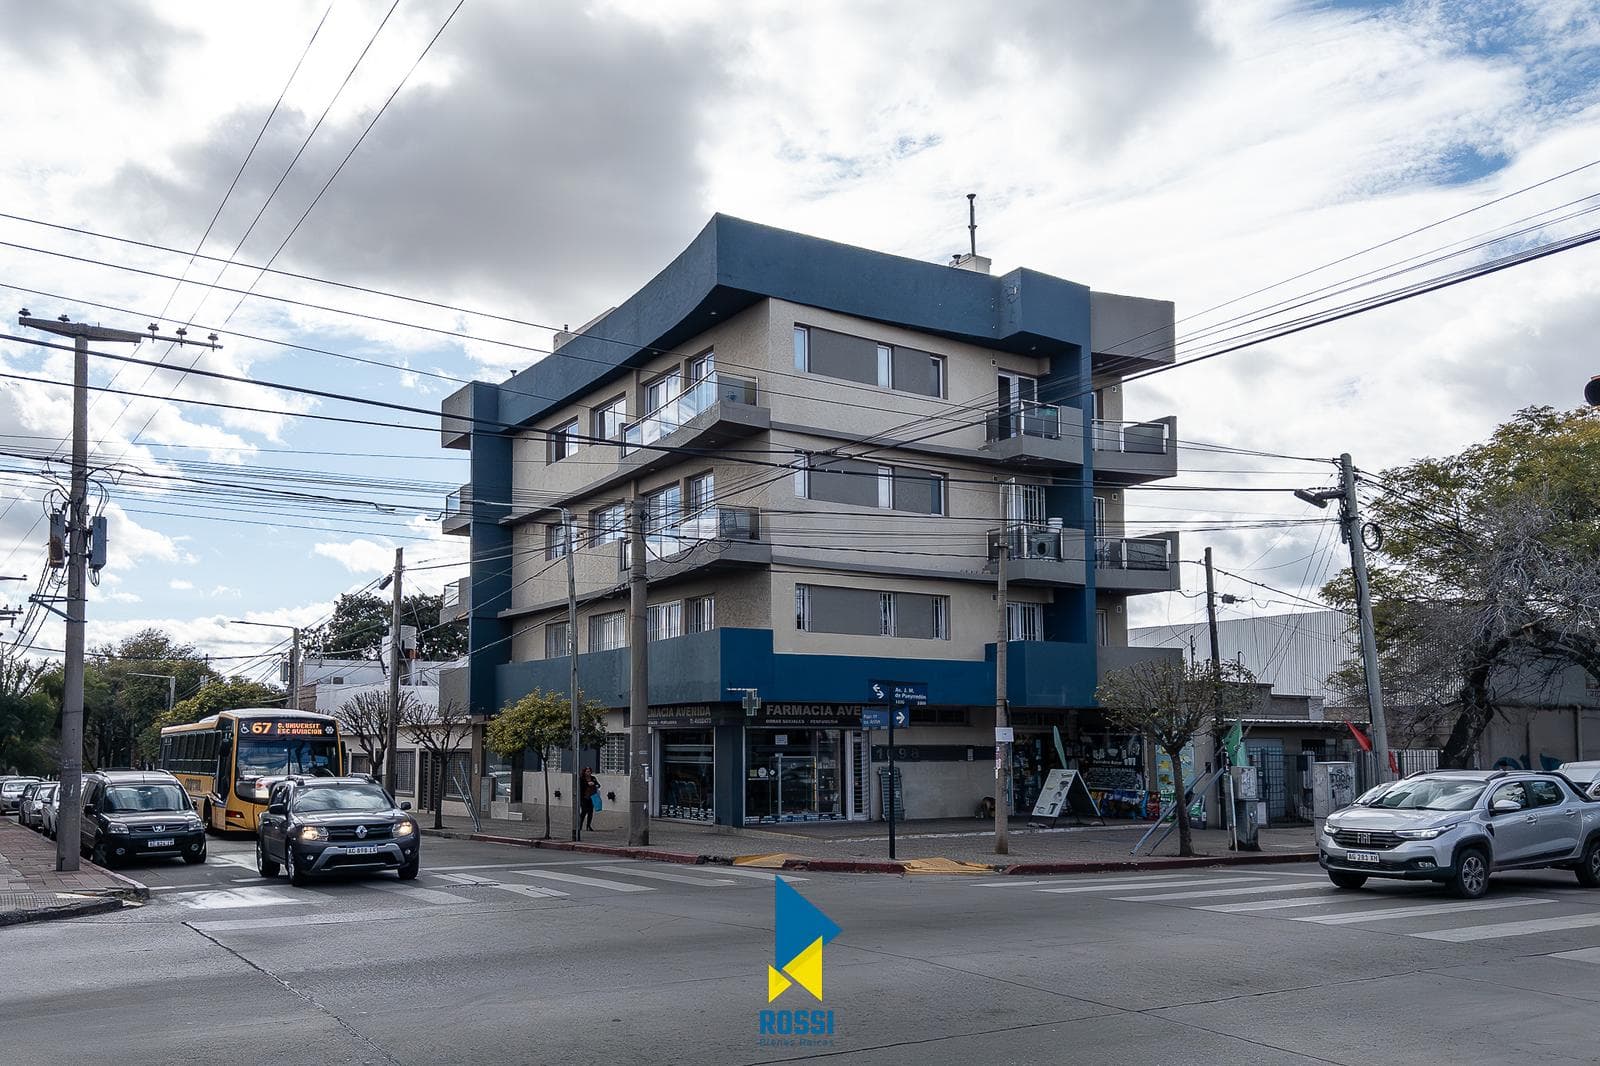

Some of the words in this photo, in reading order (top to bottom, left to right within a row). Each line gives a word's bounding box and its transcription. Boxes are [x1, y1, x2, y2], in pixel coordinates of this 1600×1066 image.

[648, 708, 674, 717] MACIA
[675, 705, 711, 716] AVENIDA
[766, 704, 833, 716] FARMACIA
[252, 722, 272, 735] 67
